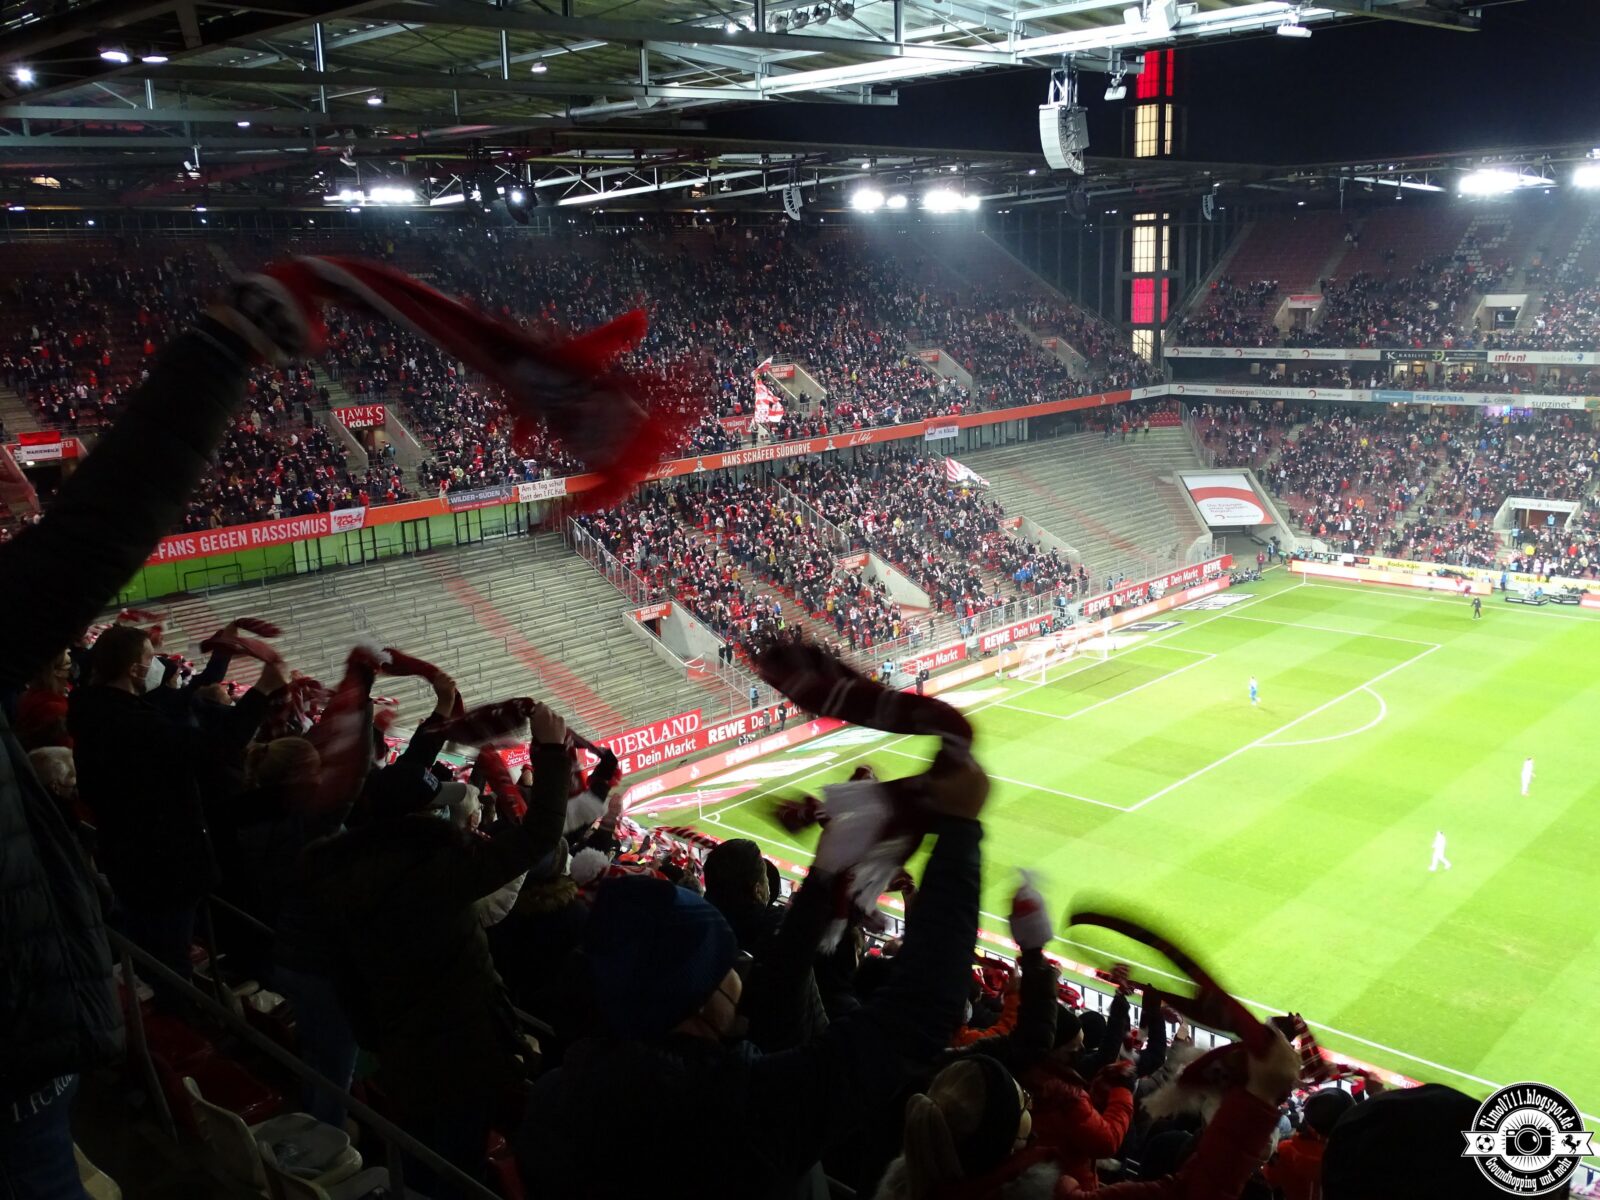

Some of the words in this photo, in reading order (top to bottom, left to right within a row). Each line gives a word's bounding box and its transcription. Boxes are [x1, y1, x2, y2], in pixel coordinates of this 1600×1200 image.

[332, 406, 384, 425] HAWKS
[349, 419, 374, 428] KÖLN
[722, 453, 741, 467] HANS
[743, 447, 775, 463] SCHÄFER
[776, 442, 812, 458] SÜDKURVE
[148, 537, 196, 562] -FANS
[200, 529, 248, 553] GEGEN
[252, 517, 328, 544] RASSISMUS
[1088, 597, 1111, 615] REWE
[1170, 575, 1183, 586] Dein
[1182, 568, 1199, 581] Markt
[1202, 559, 1223, 578] REWE
[984, 630, 1010, 650] REWE
[1014, 625, 1029, 640] Dein
[935, 649, 959, 667] Markt
[584, 713, 699, 768] SUERLAND
[637, 751, 661, 769] Dein
[664, 738, 696, 759] Markt
[708, 719, 747, 744] REWE
[29, 1086, 54, 1115] FC
